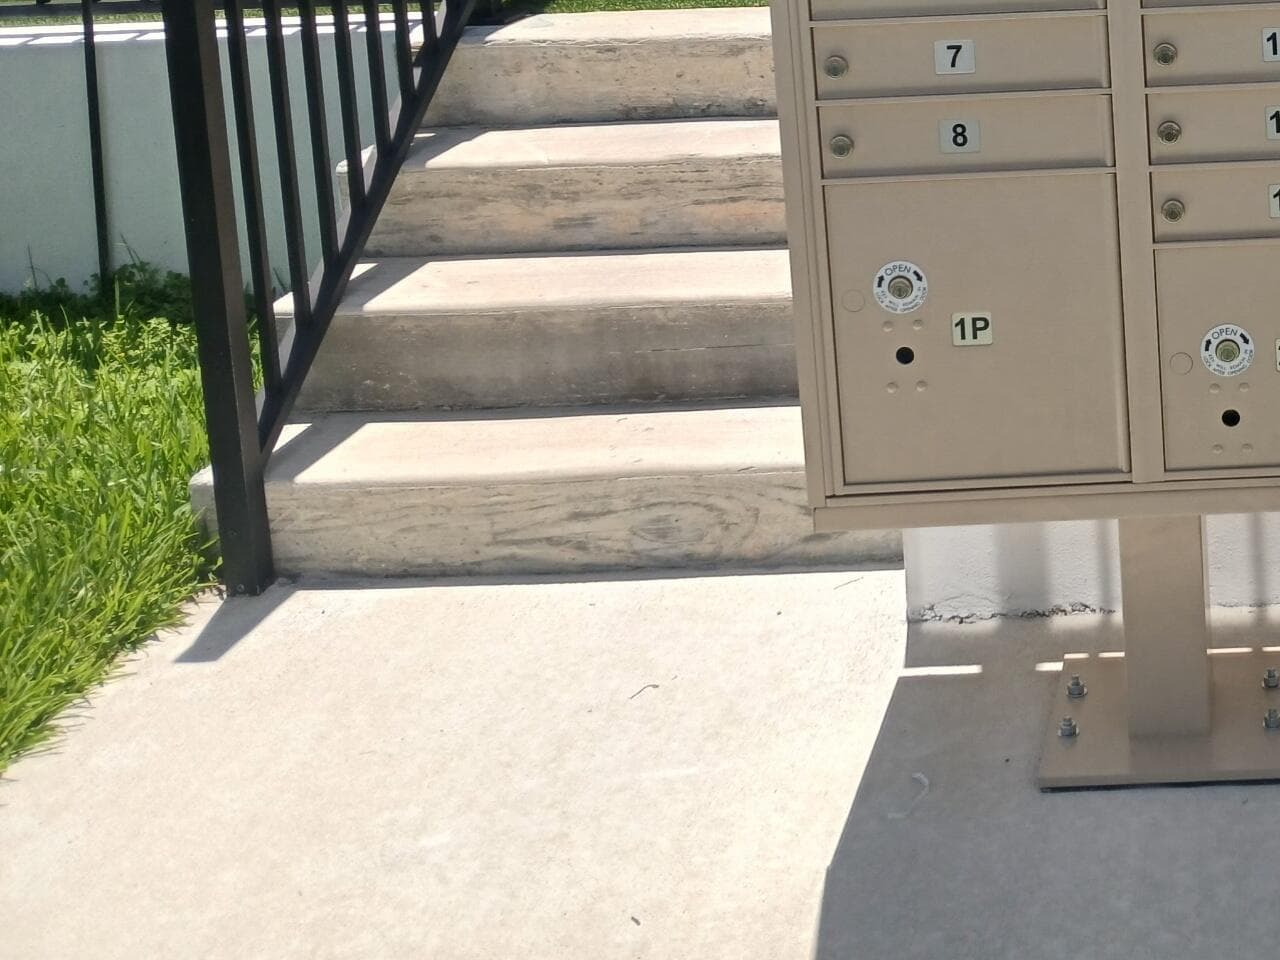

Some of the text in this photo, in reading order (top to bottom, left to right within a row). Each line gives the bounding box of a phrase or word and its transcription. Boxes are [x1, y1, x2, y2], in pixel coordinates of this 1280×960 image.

[946, 44, 963, 68] 7
[952, 123, 968, 147] 8
[884, 264, 911, 276] OPEN
[954, 316, 990, 341] 1P
[1211, 328, 1238, 339] OPEN
